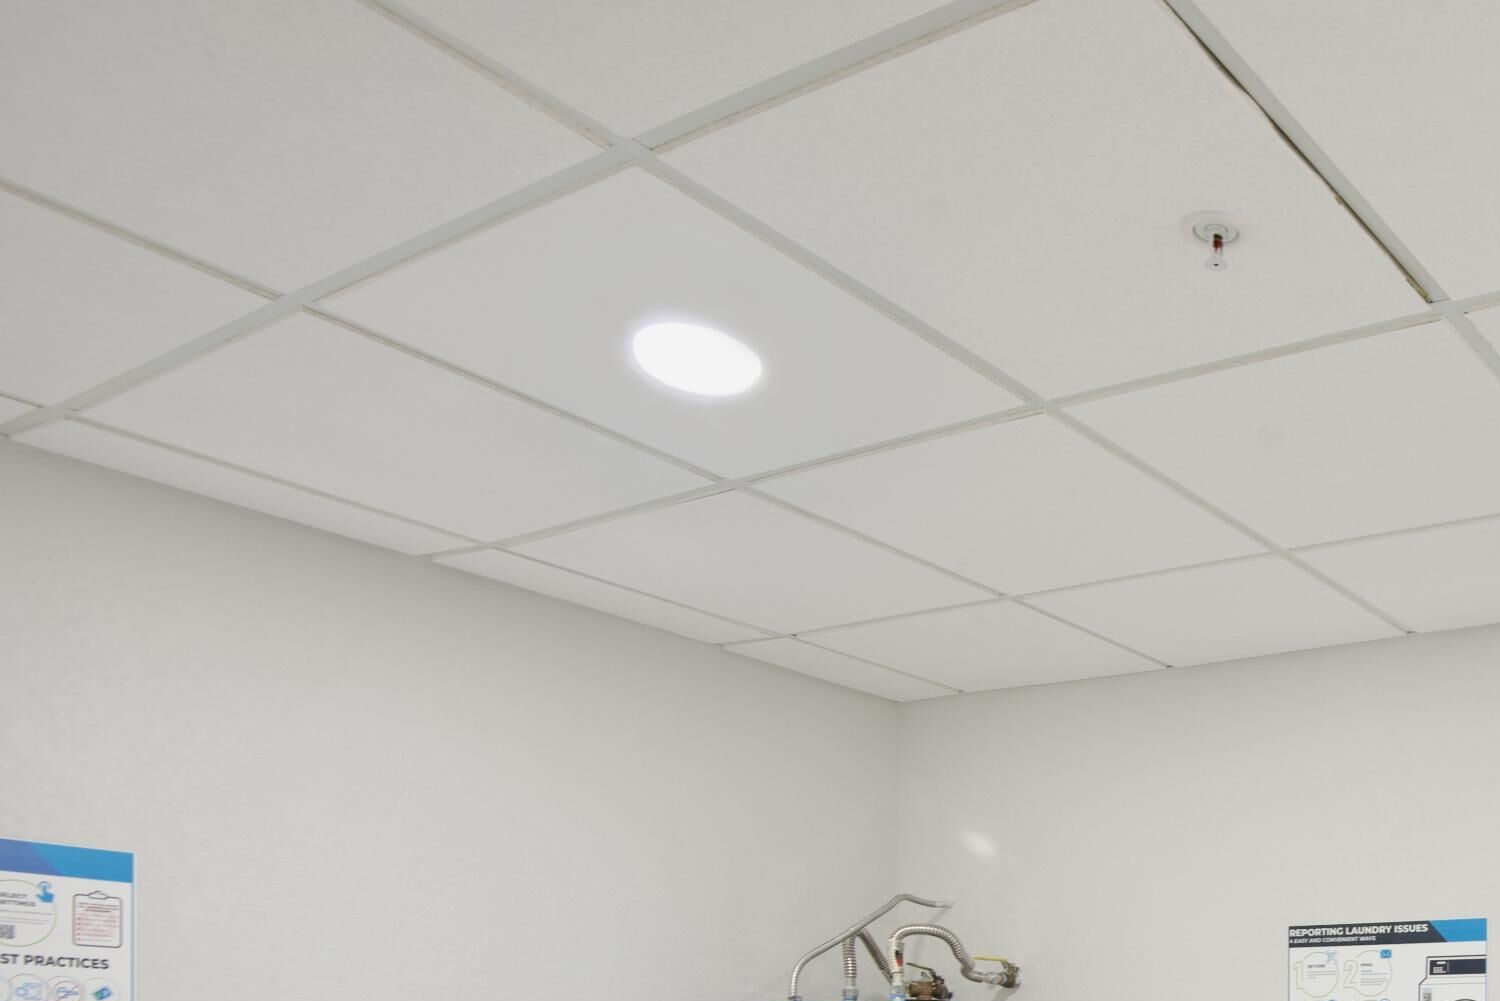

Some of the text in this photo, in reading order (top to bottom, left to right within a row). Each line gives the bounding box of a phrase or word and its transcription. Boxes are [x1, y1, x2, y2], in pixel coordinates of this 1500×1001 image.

[1289, 924, 1429, 937] REPORTING LAUNDRY ISSUES
[24, 954, 109, 969] PRACTICES
